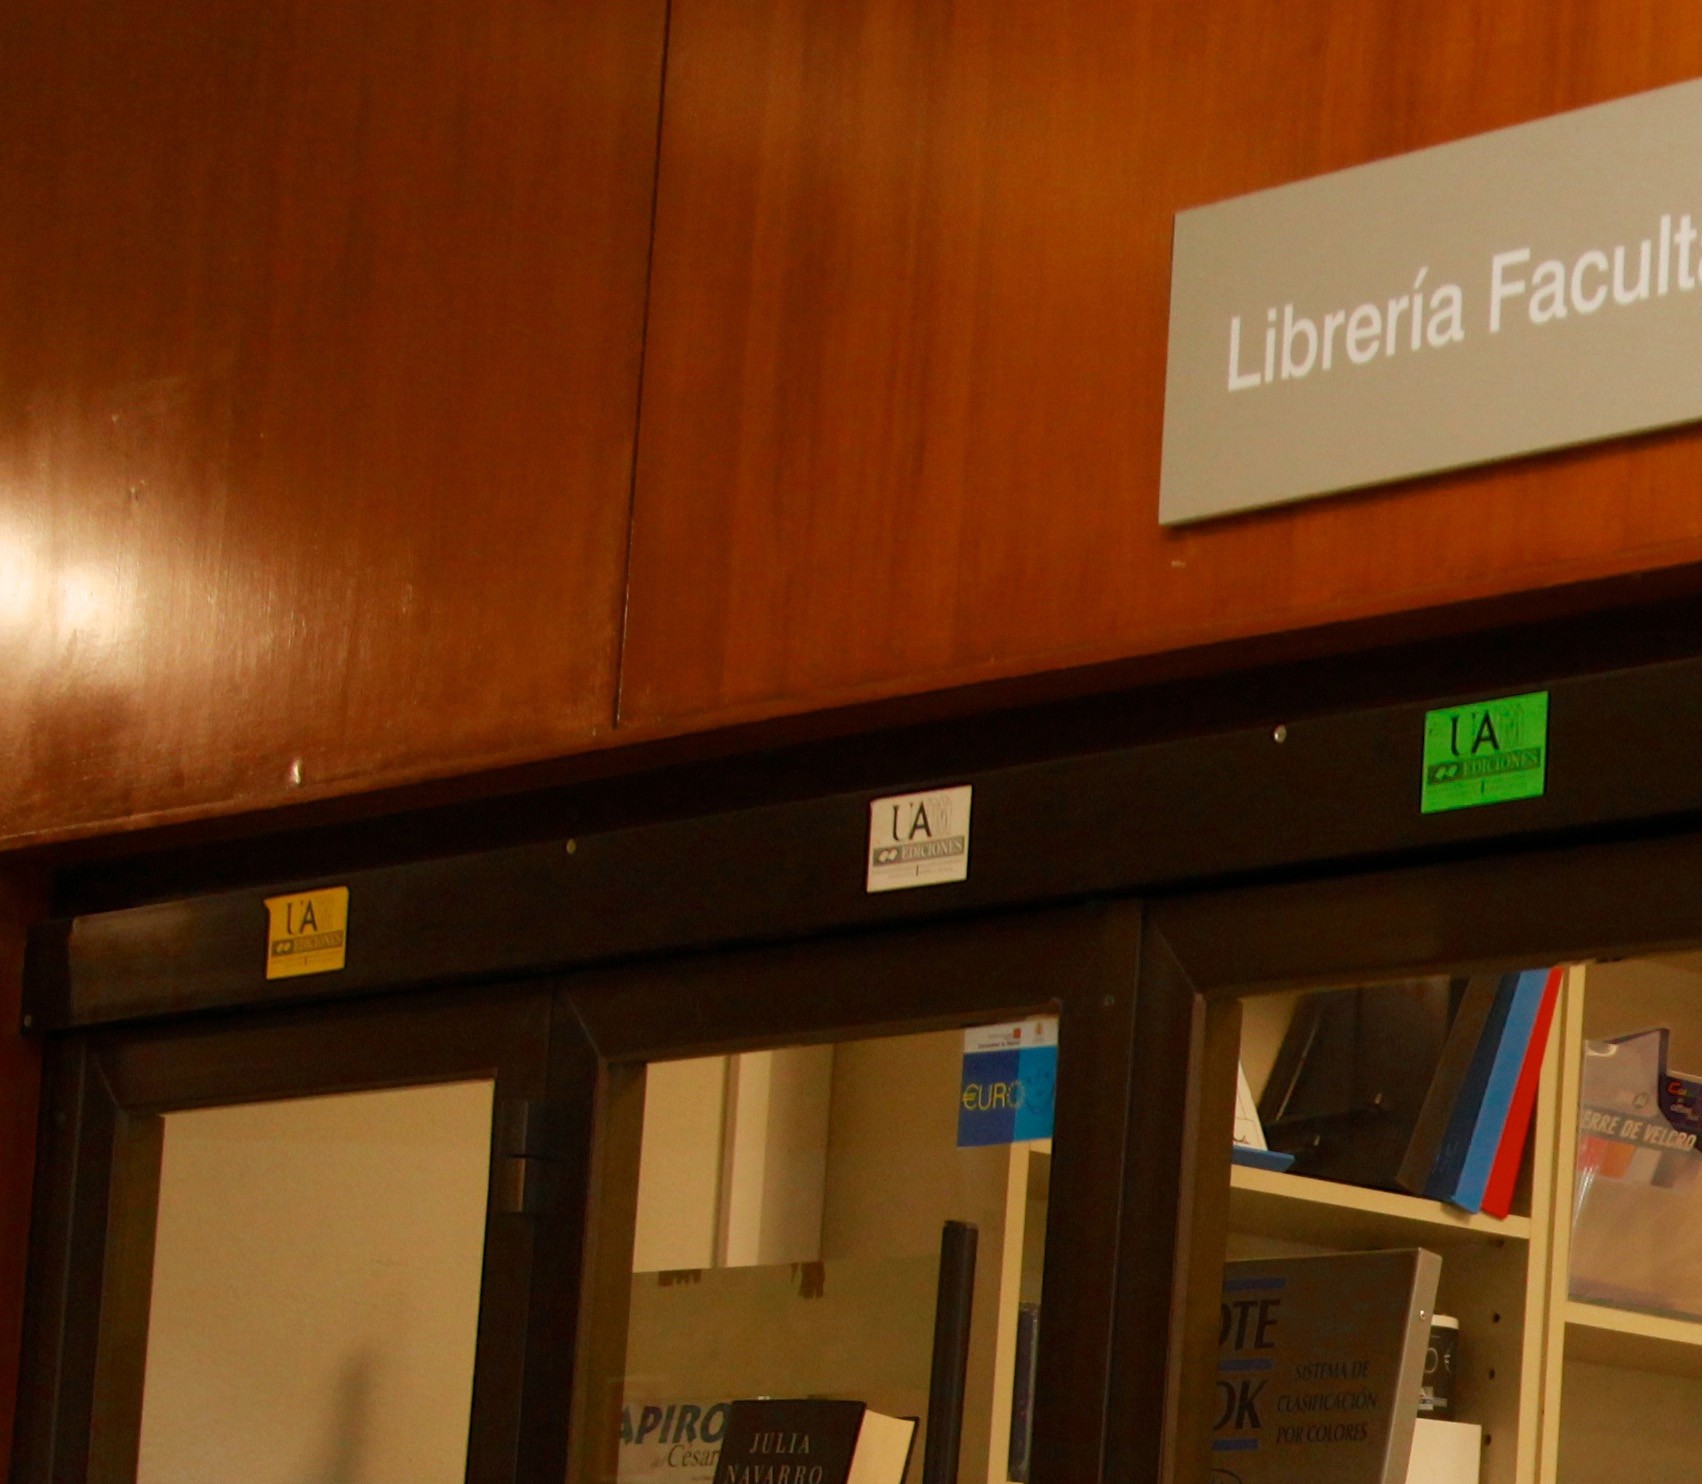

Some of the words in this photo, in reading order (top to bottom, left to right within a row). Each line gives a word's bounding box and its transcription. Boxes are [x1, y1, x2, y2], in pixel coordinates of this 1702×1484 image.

[1228, 266, 1464, 391] Librería
[1620, 1119, 1643, 1140] DE
[1644, 1123, 1697, 1152] VELCRO
[1295, 1363, 1348, 1381] SISTEMA
[1351, 1360, 1371, 1379] DE
[1277, 1389, 1378, 1412] CLASIFICACIÓN
[749, 1431, 813, 1455] JULIA
[1277, 1424, 1302, 1443] POR
[1305, 1422, 1369, 1442] COLORES
[666, 1441, 718, 1468] César
